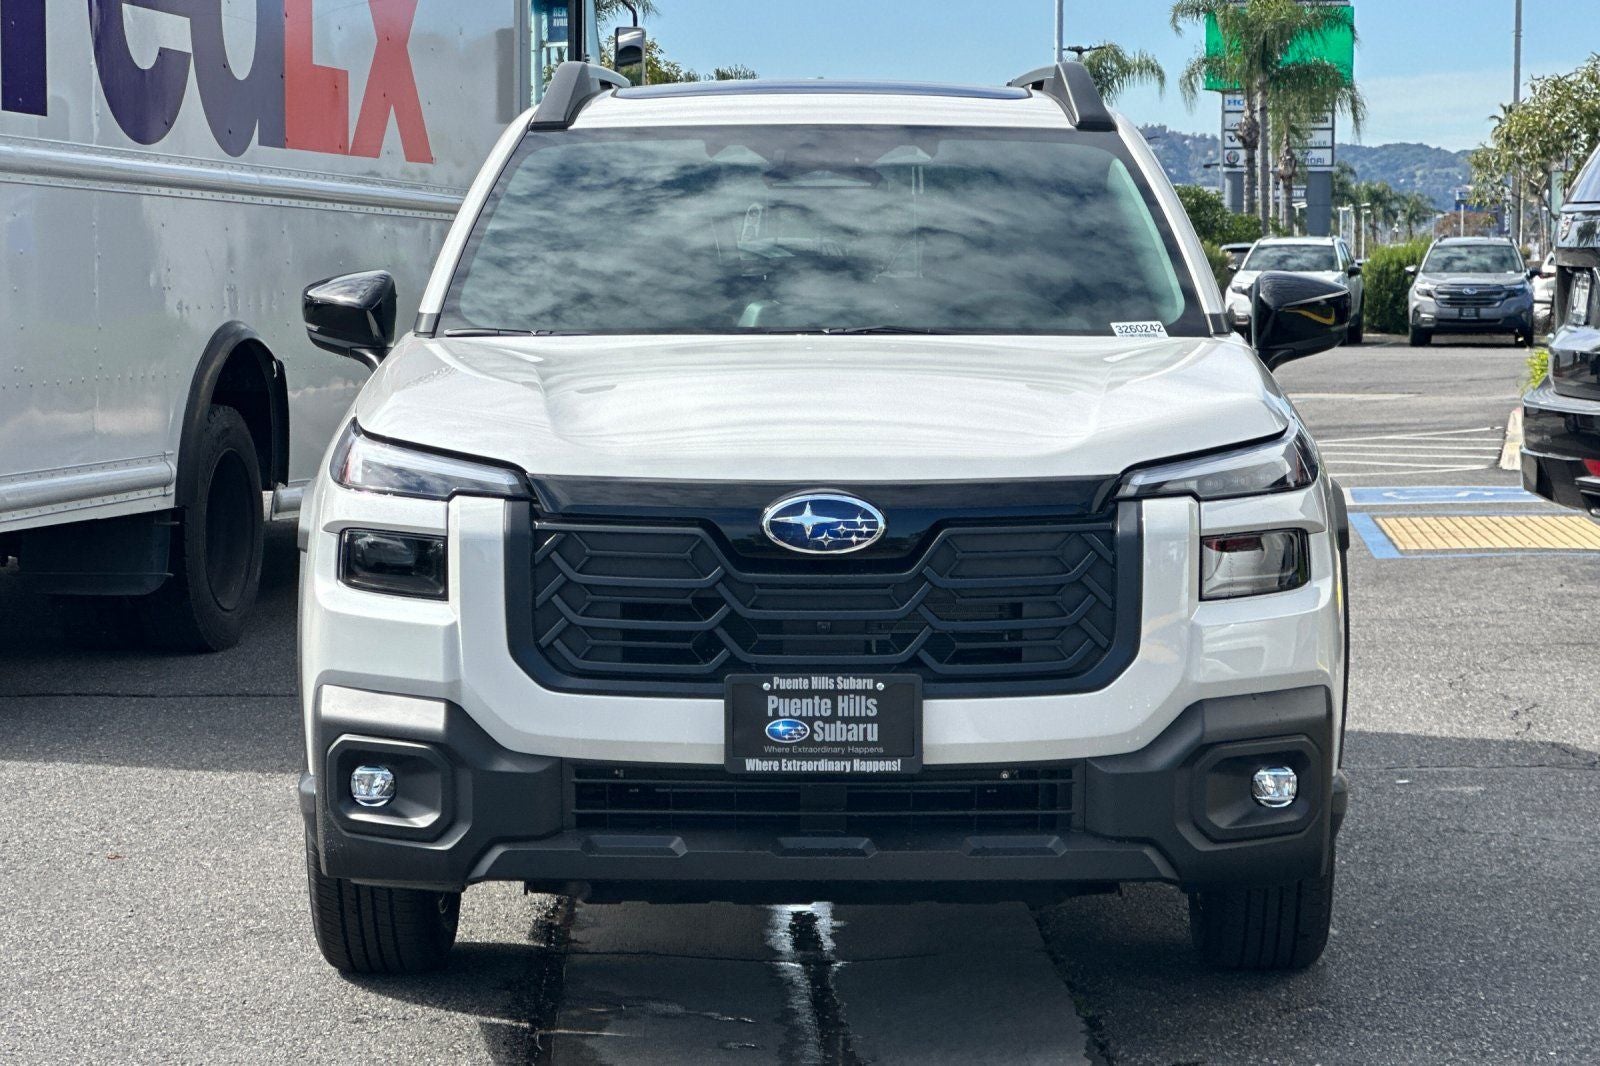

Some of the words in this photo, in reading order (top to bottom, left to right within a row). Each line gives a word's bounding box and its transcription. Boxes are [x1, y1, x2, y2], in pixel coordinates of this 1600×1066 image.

[1115, 323, 1164, 333] 3260242
[773, 676, 810, 690] Puente
[811, 676, 835, 690] Hills
[836, 676, 874, 690] Subaru
[767, 694, 832, 717] Puente
[837, 694, 878, 717] Hills
[813, 720, 879, 742] Subaru
[764, 745, 790, 754] Where
[792, 745, 846, 755] Extraordinary
[848, 745, 884, 755] Happens
[745, 758, 780, 772] Where
[781, 758, 852, 773] Extraordinary
[853, 758, 902, 774] Happens!
